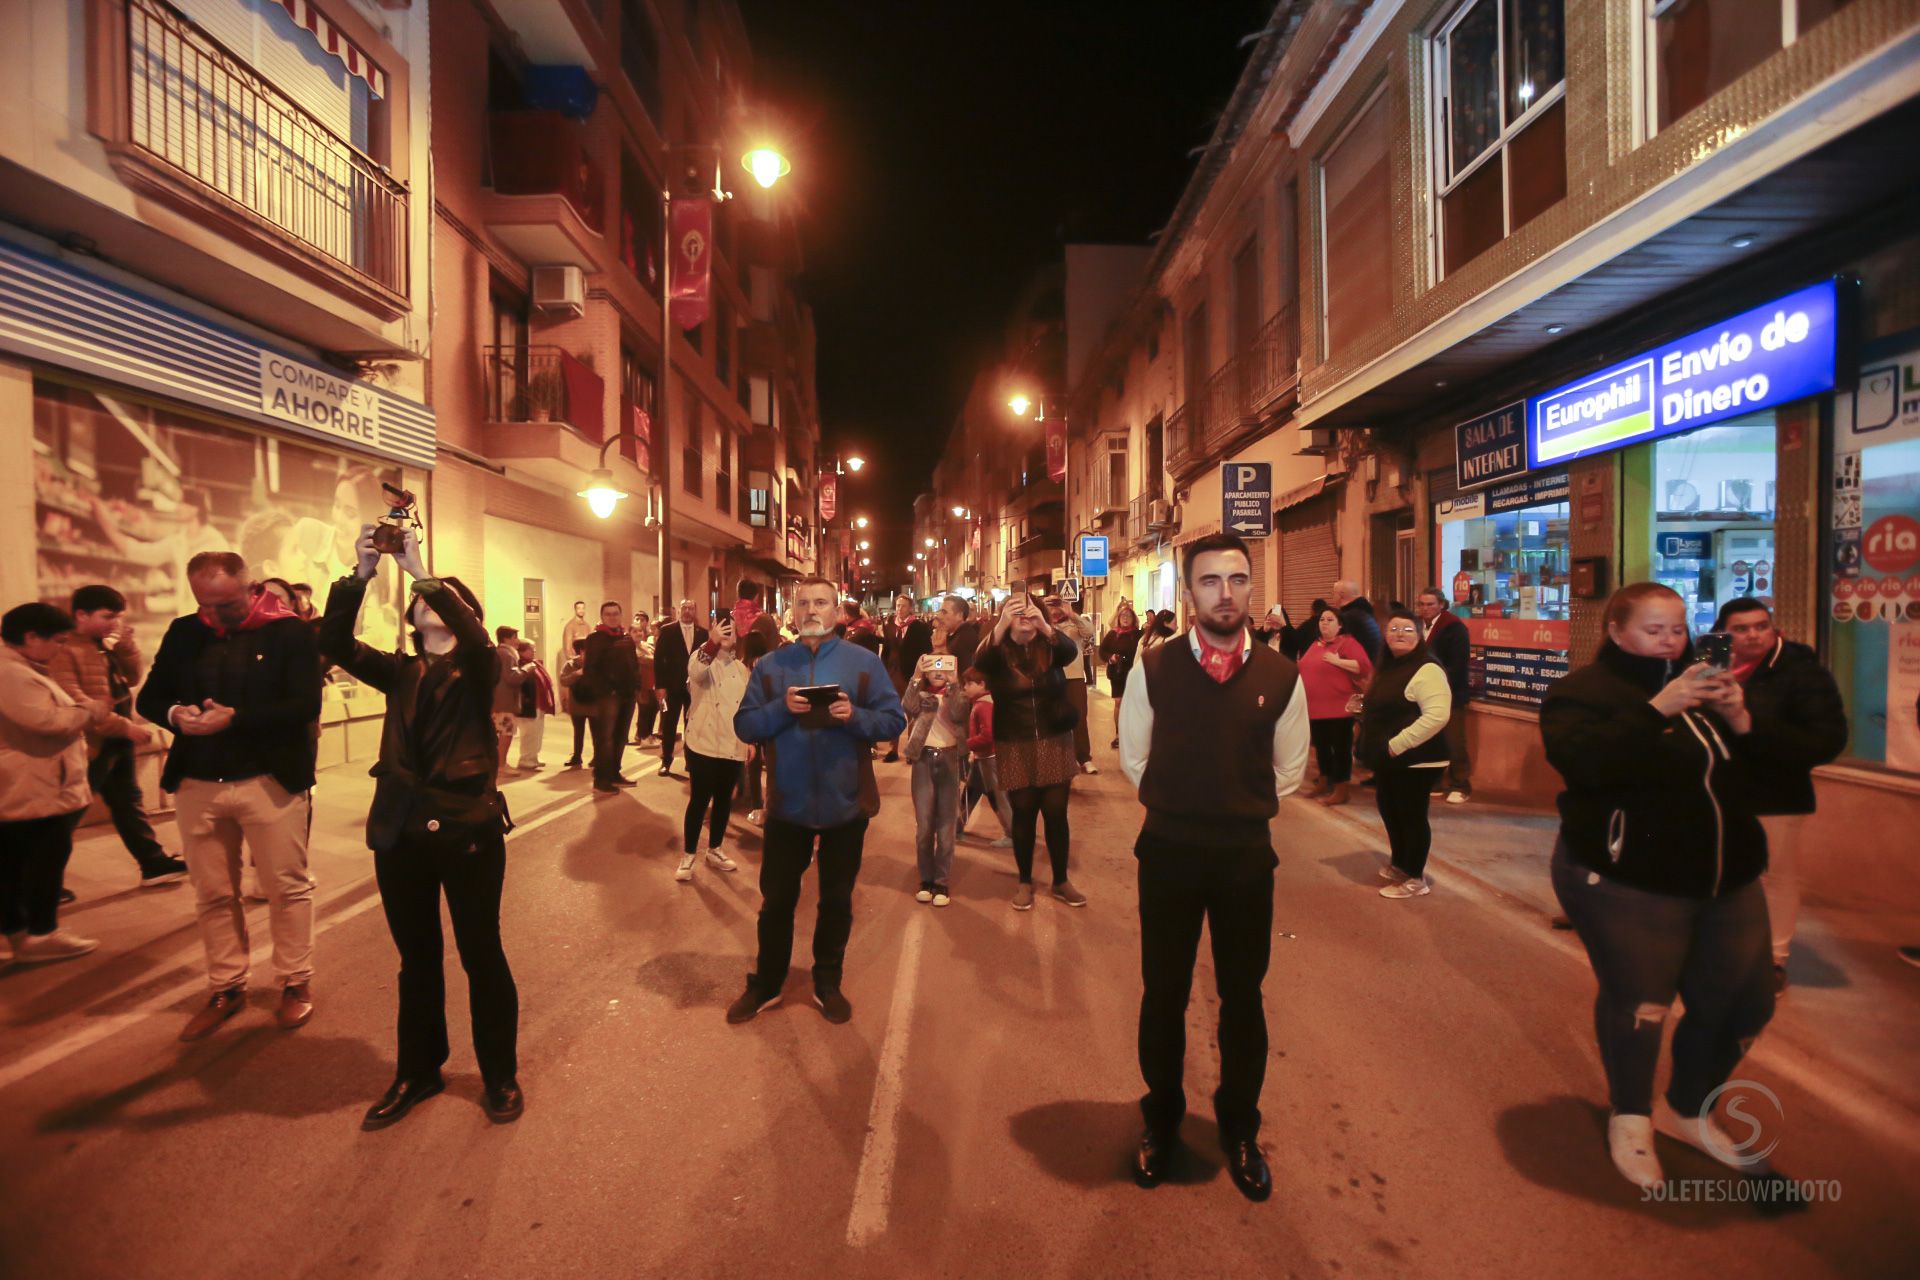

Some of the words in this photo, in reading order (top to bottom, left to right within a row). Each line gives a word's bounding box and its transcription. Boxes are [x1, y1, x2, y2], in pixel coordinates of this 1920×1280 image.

[1661, 331, 1753, 386] Envío
[1760, 311, 1810, 351] de
[269, 359, 359, 407] COMPARE
[364, 393, 373, 411] Y
[1546, 373, 1641, 431] Europhil
[1661, 373, 1770, 426] Dinero
[271, 387, 374, 440] AHORRE
[1465, 420, 1496, 449] SALA
[1499, 412, 1515, 438] DE
[1463, 443, 1520, 480] INTERNET
[1237, 466, 1257, 491] P
[1224, 491, 1270, 499] APARCAMIENTO
[1492, 483, 1528, 497] LLAMADAS
[1492, 495, 1528, 508] RECARGAS
[1232, 509, 1262, 517] PASARELA
[1868, 522, 1917, 553] ria
[1454, 575, 1469, 592] ria
[1857, 580, 1876, 592] ria
[1881, 578, 1901, 591] ria
[1483, 623, 1500, 640] ria
[1533, 624, 1553, 643] ria
[1486, 663, 1516, 673] IMPRIMIR
[1521, 666, 1534, 676] FAX
[1486, 677, 1500, 685] PLAY
[1501, 678, 1527, 689] STATION
